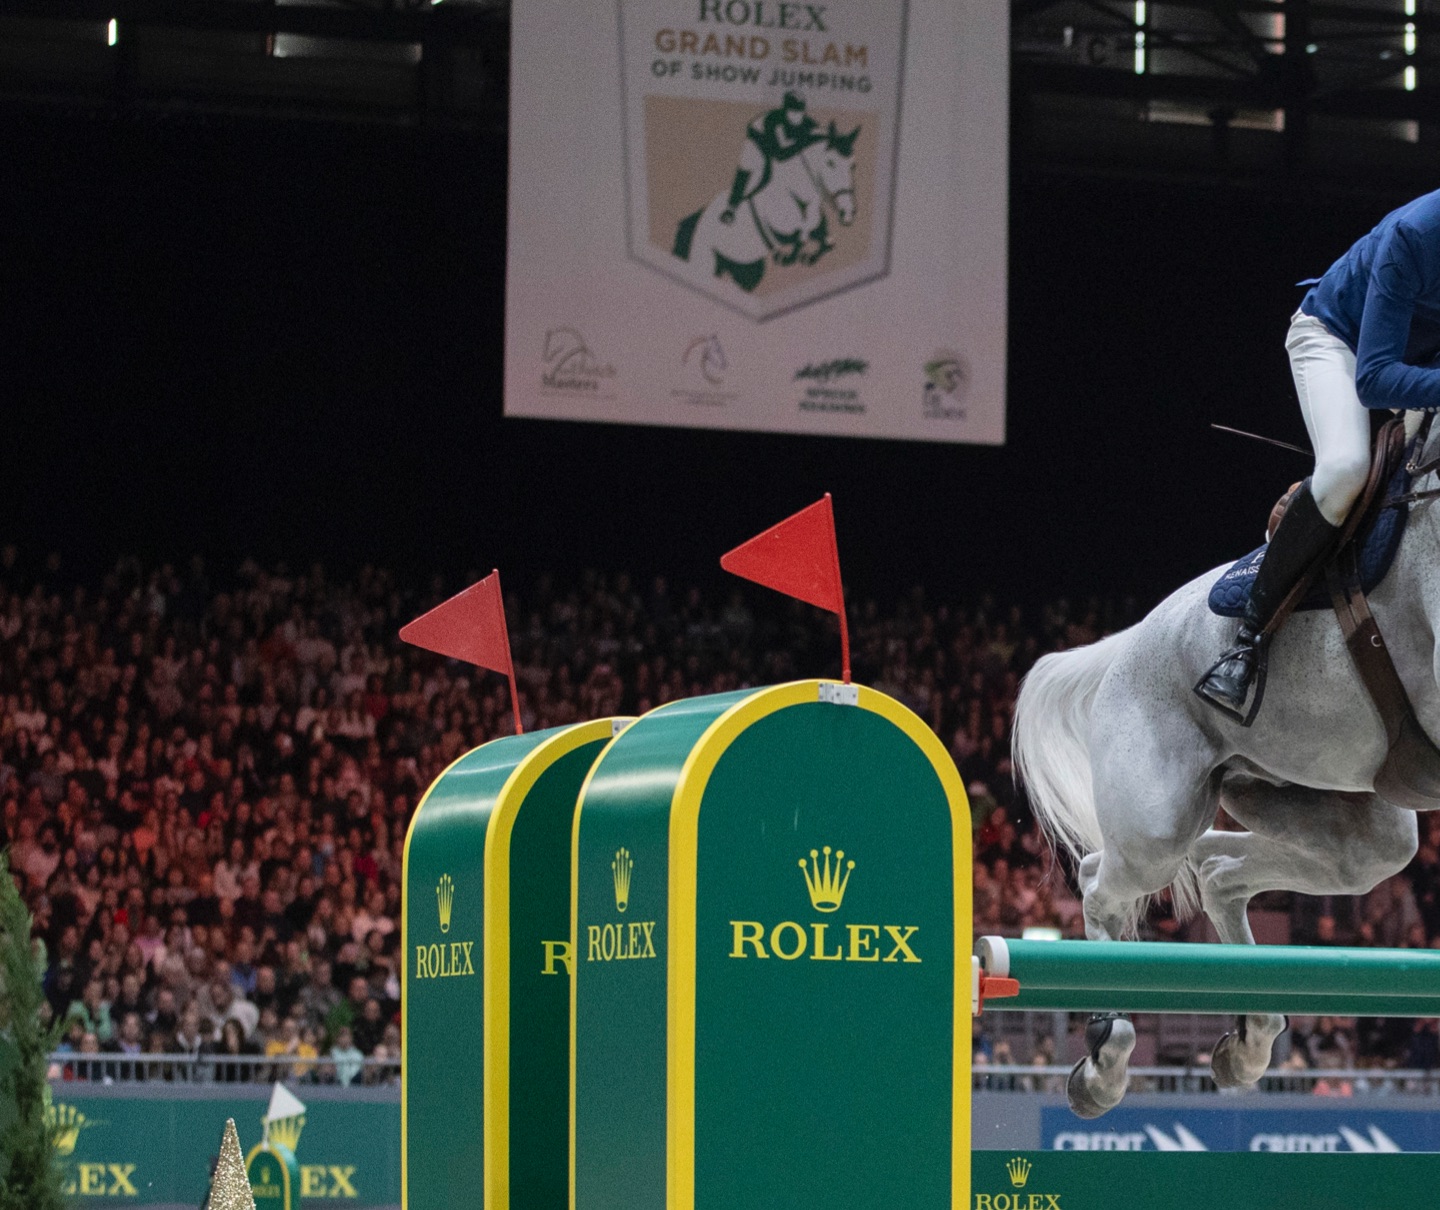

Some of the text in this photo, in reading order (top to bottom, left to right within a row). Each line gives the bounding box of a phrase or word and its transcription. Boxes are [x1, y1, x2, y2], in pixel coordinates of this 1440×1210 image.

[699, 0, 827, 31] ROLEX
[655, 28, 869, 67] GRAND SLAM
[651, 59, 873, 94] OF SHOW JUMPING
[416, 941, 475, 979] ROLEX
[587, 921, 657, 962] ROLEX
[728, 921, 923, 963] ROLEX
[975, 1193, 1062, 1210] ROLEX
